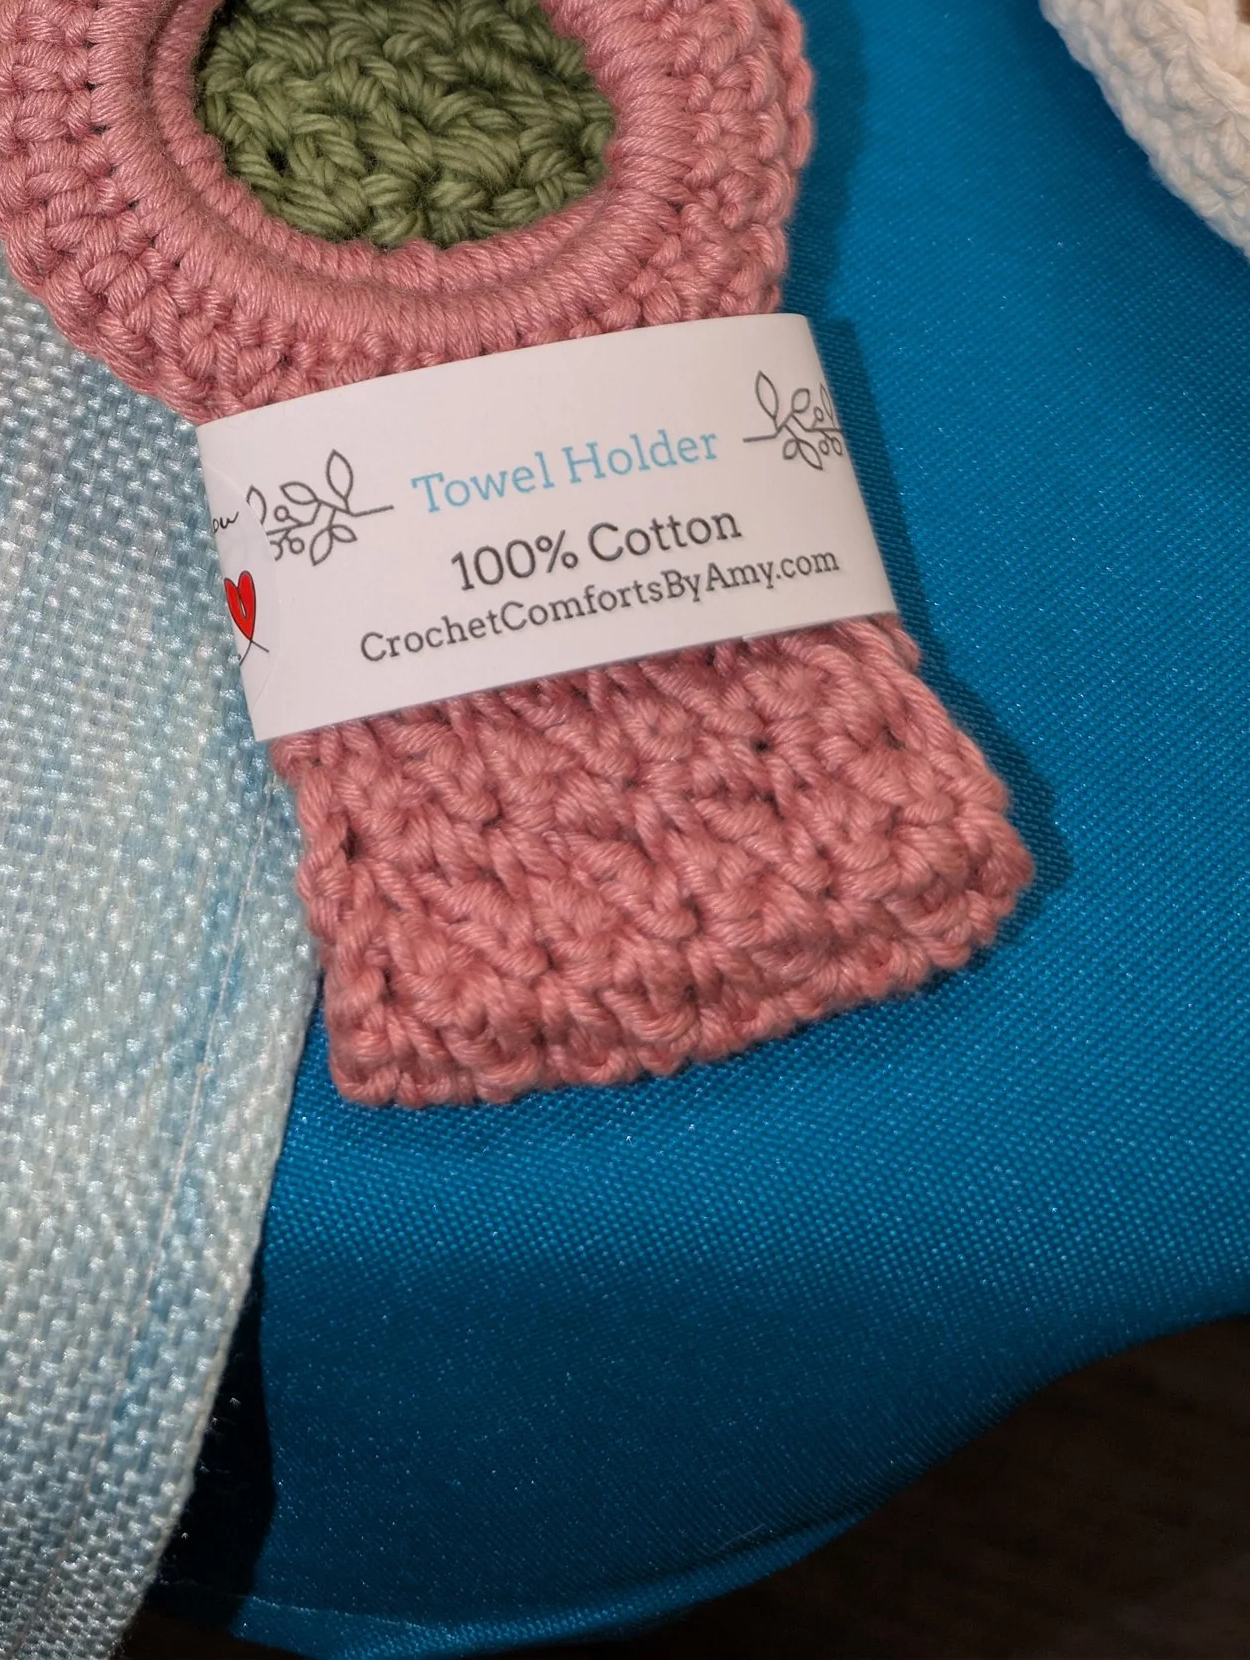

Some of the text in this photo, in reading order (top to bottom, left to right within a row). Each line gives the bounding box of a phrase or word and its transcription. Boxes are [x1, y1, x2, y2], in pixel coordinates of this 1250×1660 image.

[412, 430, 718, 514] Towel Holder
[452, 510, 742, 591] 100% Cotton
[360, 548, 840, 662] CrochetComfortsByAmy.com
